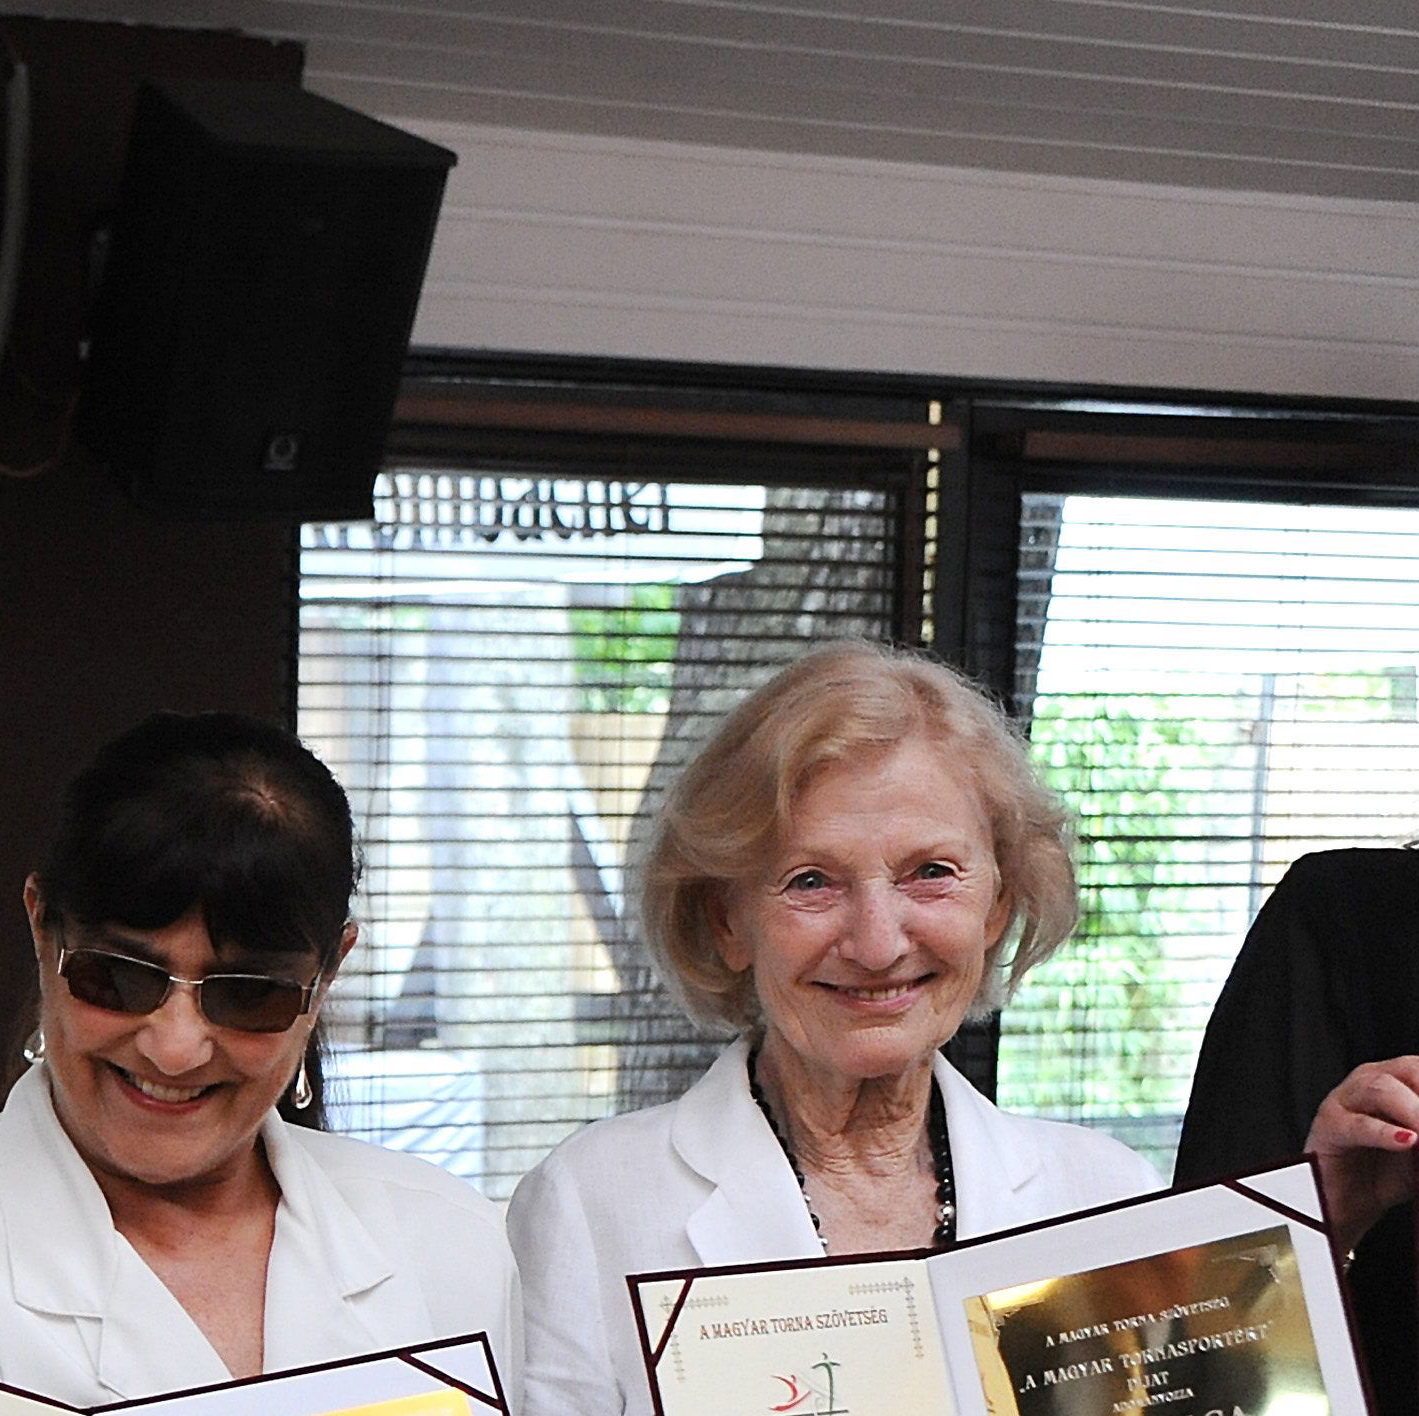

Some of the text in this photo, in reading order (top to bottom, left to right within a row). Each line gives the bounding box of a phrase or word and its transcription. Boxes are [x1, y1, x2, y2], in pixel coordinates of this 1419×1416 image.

[696, 1304, 890, 1340] A MAGYAR TORNA SZÖVETSÉG
[1043, 1293, 1232, 1348] A MAGYAR TORNA SZÖVETSÉG
[1040, 1354, 1115, 1386] MAGYAR
